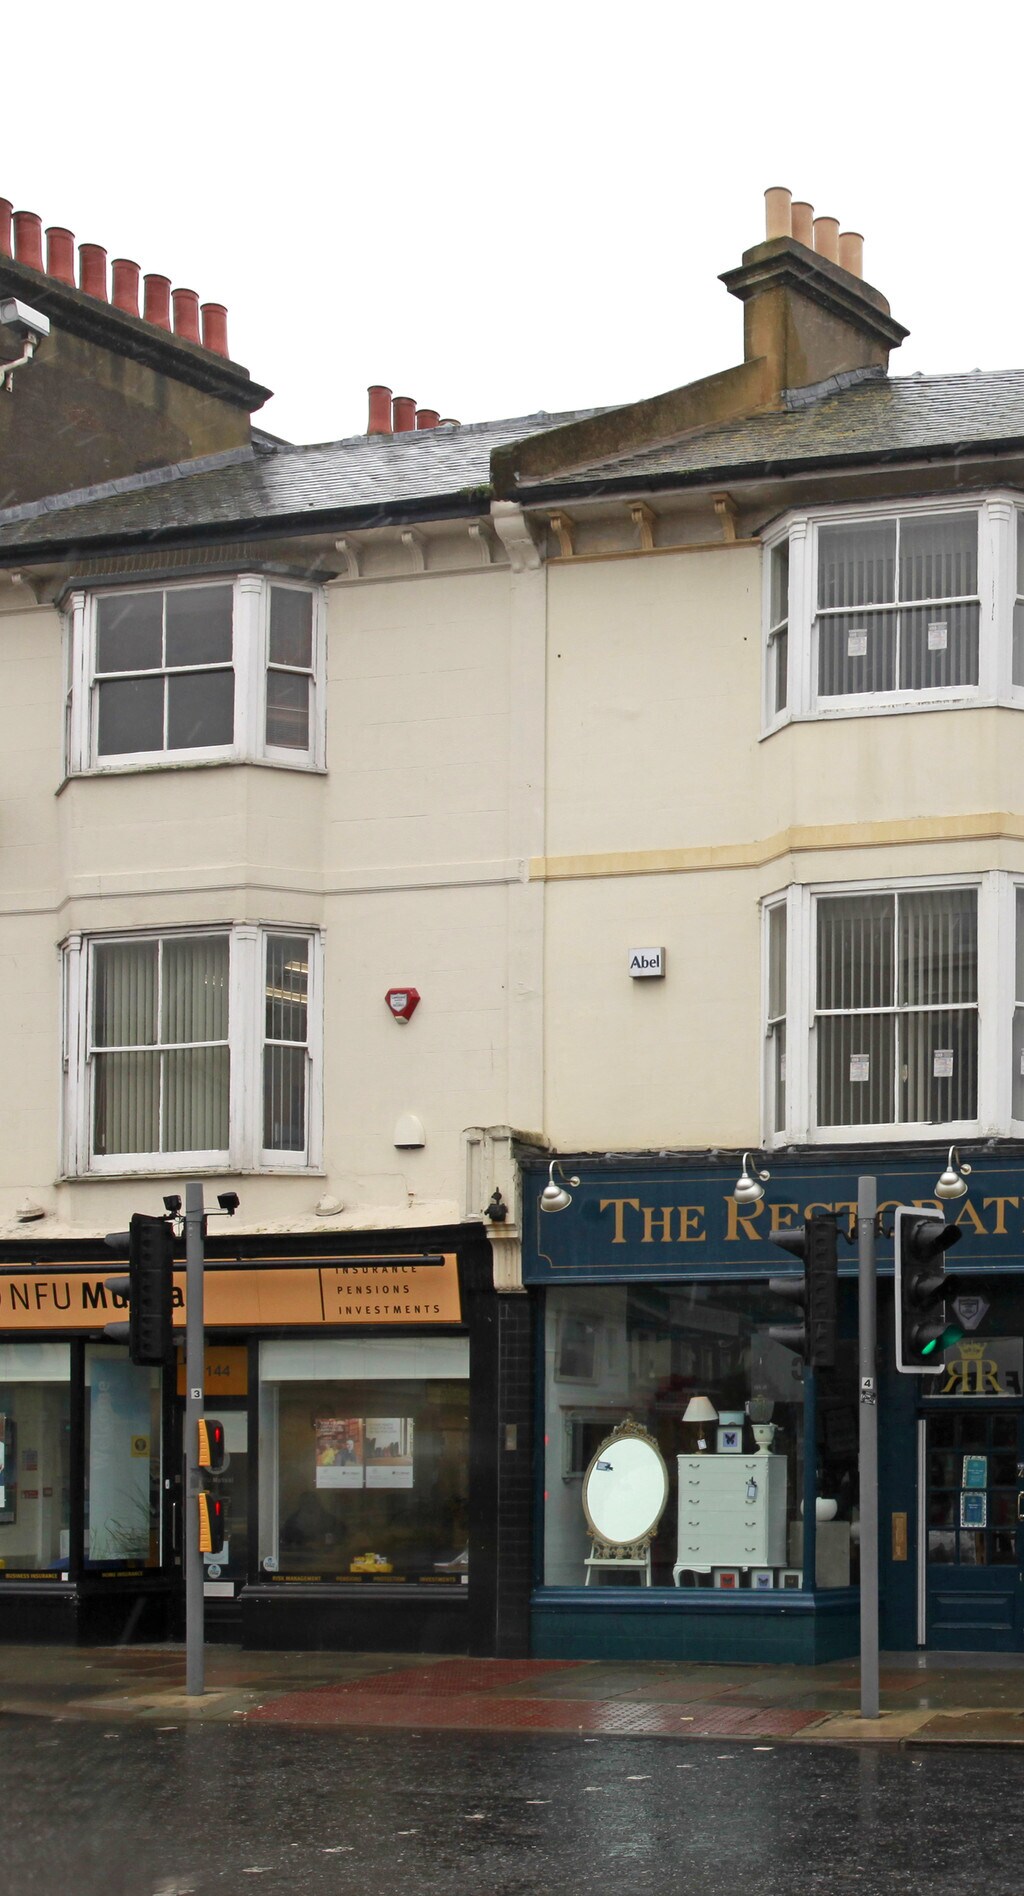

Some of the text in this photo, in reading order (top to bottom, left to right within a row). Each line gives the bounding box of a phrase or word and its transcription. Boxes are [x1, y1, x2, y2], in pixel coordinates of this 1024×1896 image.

[630, 955, 660, 969] Abel
[335, 1266, 417, 1274] INSURANCE
[337, 1285, 410, 1294] PENSIONS
[10, 1282, 71, 1310] NFU
[338, 1304, 440, 1314] INVESTMENTS
[206, 1365, 230, 1376] 144
[863, 1378, 871, 1388] 4
[193, 1389, 201, 1398] 3
